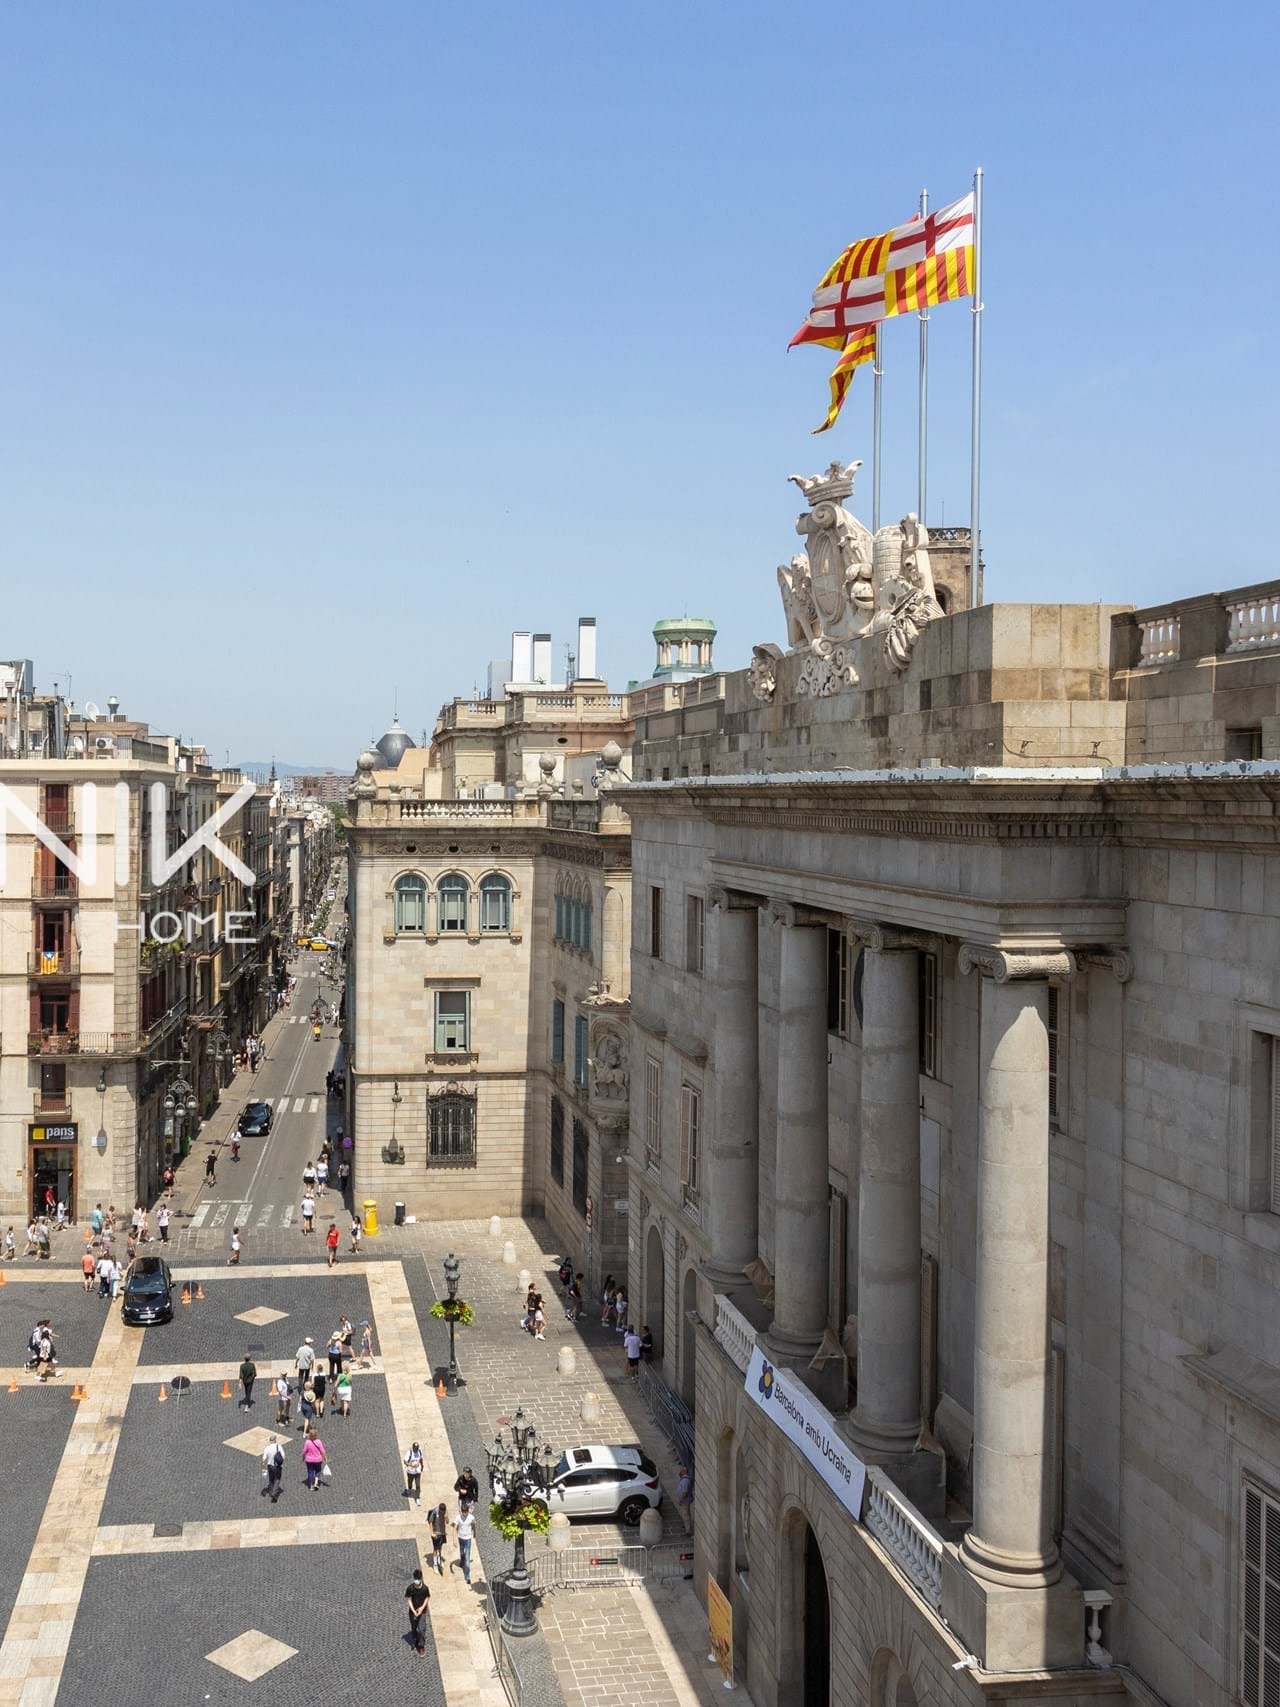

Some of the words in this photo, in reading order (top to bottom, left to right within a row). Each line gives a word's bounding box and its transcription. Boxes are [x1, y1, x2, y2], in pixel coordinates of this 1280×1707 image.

[46, 1127, 74, 1139] pans
[774, 1382, 804, 1429] Barcelona
[805, 1421, 821, 1448] amb
[821, 1436, 852, 1485] Ucraïna
